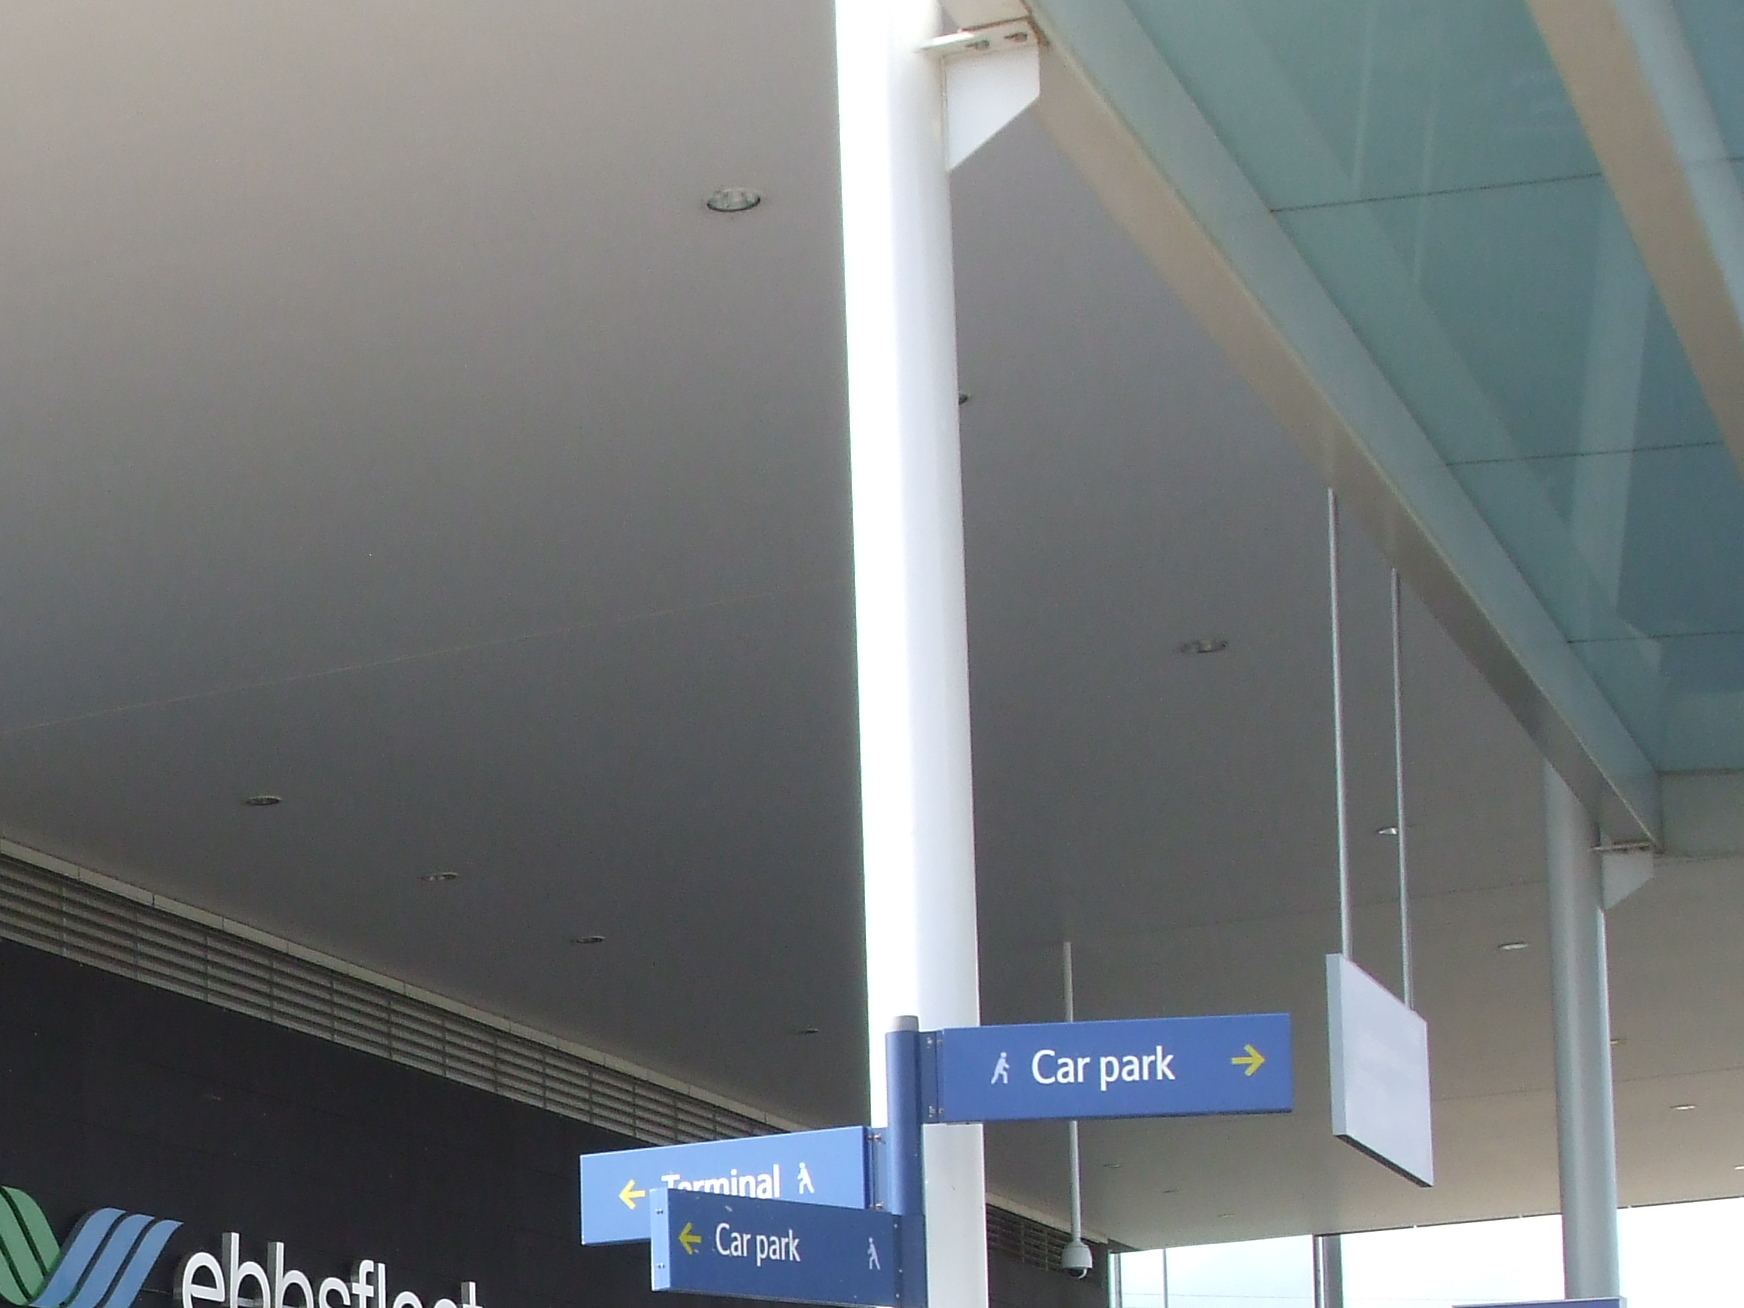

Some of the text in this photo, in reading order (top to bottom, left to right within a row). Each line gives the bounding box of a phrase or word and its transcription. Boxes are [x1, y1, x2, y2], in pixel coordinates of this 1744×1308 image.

[1032, 1045, 1176, 1091] Car park
[715, 1222, 801, 1266] Car park
